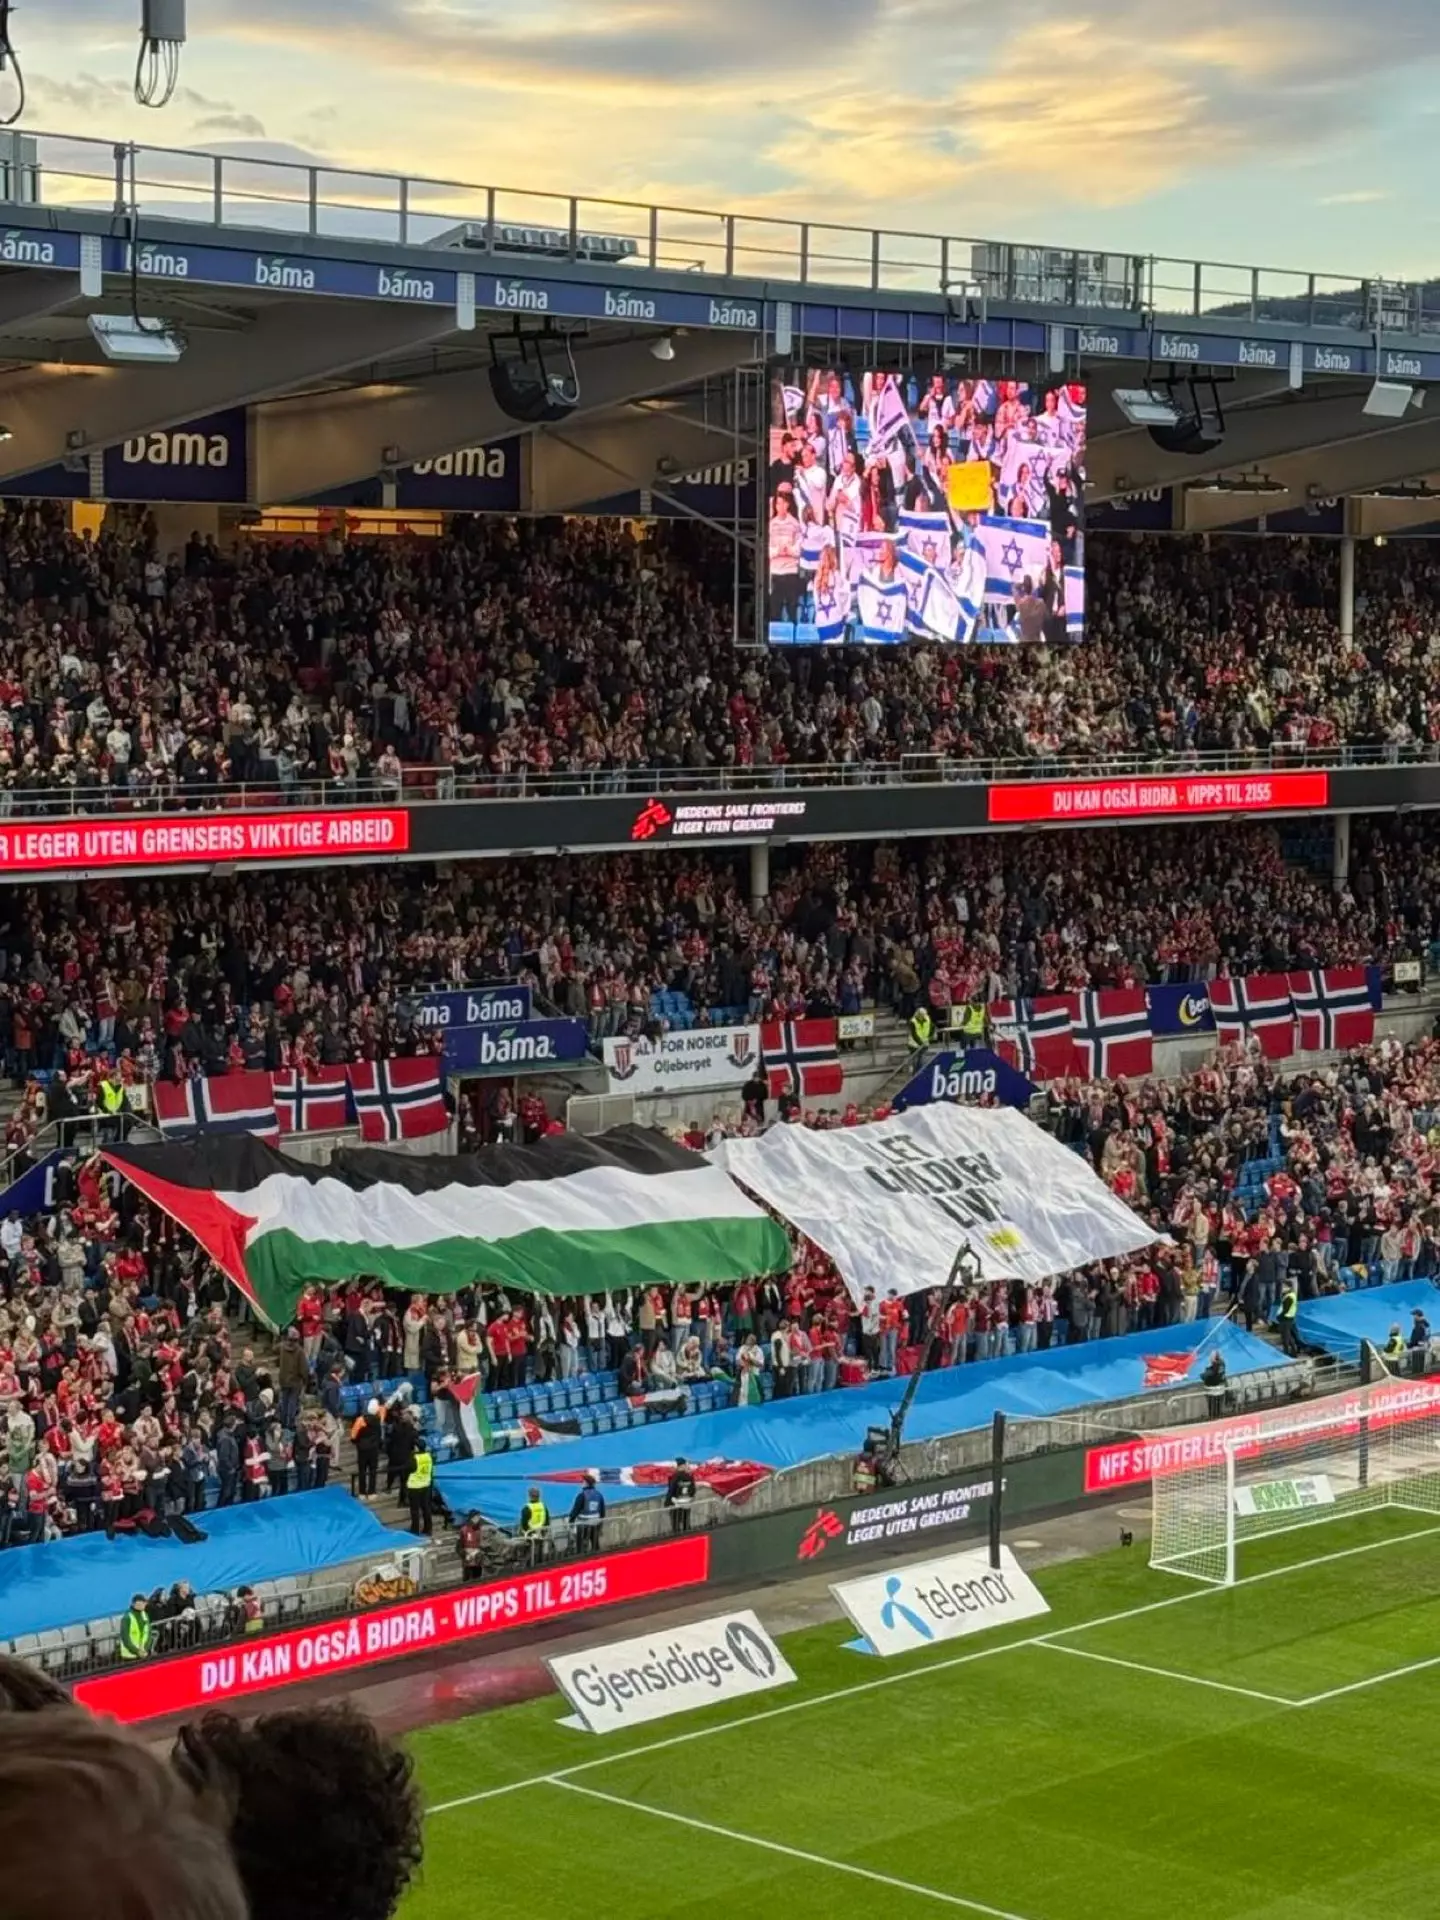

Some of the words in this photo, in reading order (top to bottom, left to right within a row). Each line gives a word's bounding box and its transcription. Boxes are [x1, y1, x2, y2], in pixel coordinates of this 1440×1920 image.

[725, 804, 749, 818] SANS
[1053, 791, 1072, 812] DU
[1074, 789, 1101, 811] KAN
[1102, 782, 1137, 809] OGSÅ
[1139, 786, 1178, 808] BIDRA
[1186, 784, 1223, 806] VIPPS
[1224, 783, 1244, 804] TIL
[14, 833, 80, 861] LEGER
[84, 829, 138, 857] UTEN
[142, 825, 245, 855] GRENSERS
[248, 821, 323, 849] VIKTIGE
[326, 818, 394, 845] ARBEID
[705, 819, 730, 833] UTEN
[660, 1039, 684, 1053] FOR
[686, 1034, 728, 1051] NORGE
[654, 1056, 712, 1074] Oljeberget
[1099, 1452, 1130, 1482] NFF
[1132, 1436, 1203, 1473] STØTTER
[850, 1499, 907, 1527] MEDECINS
[910, 1492, 939, 1514] SANS
[942, 1478, 1008, 1505] FRONTIERS
[846, 1523, 884, 1545] LEGER
[886, 1517, 917, 1537] UTEN
[919, 1505, 970, 1528] GRENSER
[915, 1572, 1016, 1620] telenor
[200, 1658, 236, 1694] DU
[241, 1646, 290, 1684] KAN
[296, 1619, 362, 1669] OGSÅ
[366, 1607, 437, 1652] BIDRA
[454, 1588, 520, 1629] VIPPS
[524, 1580, 556, 1613] TIL
[560, 1567, 608, 1603] 2155
[571, 1642, 735, 1713] Gjensidige
